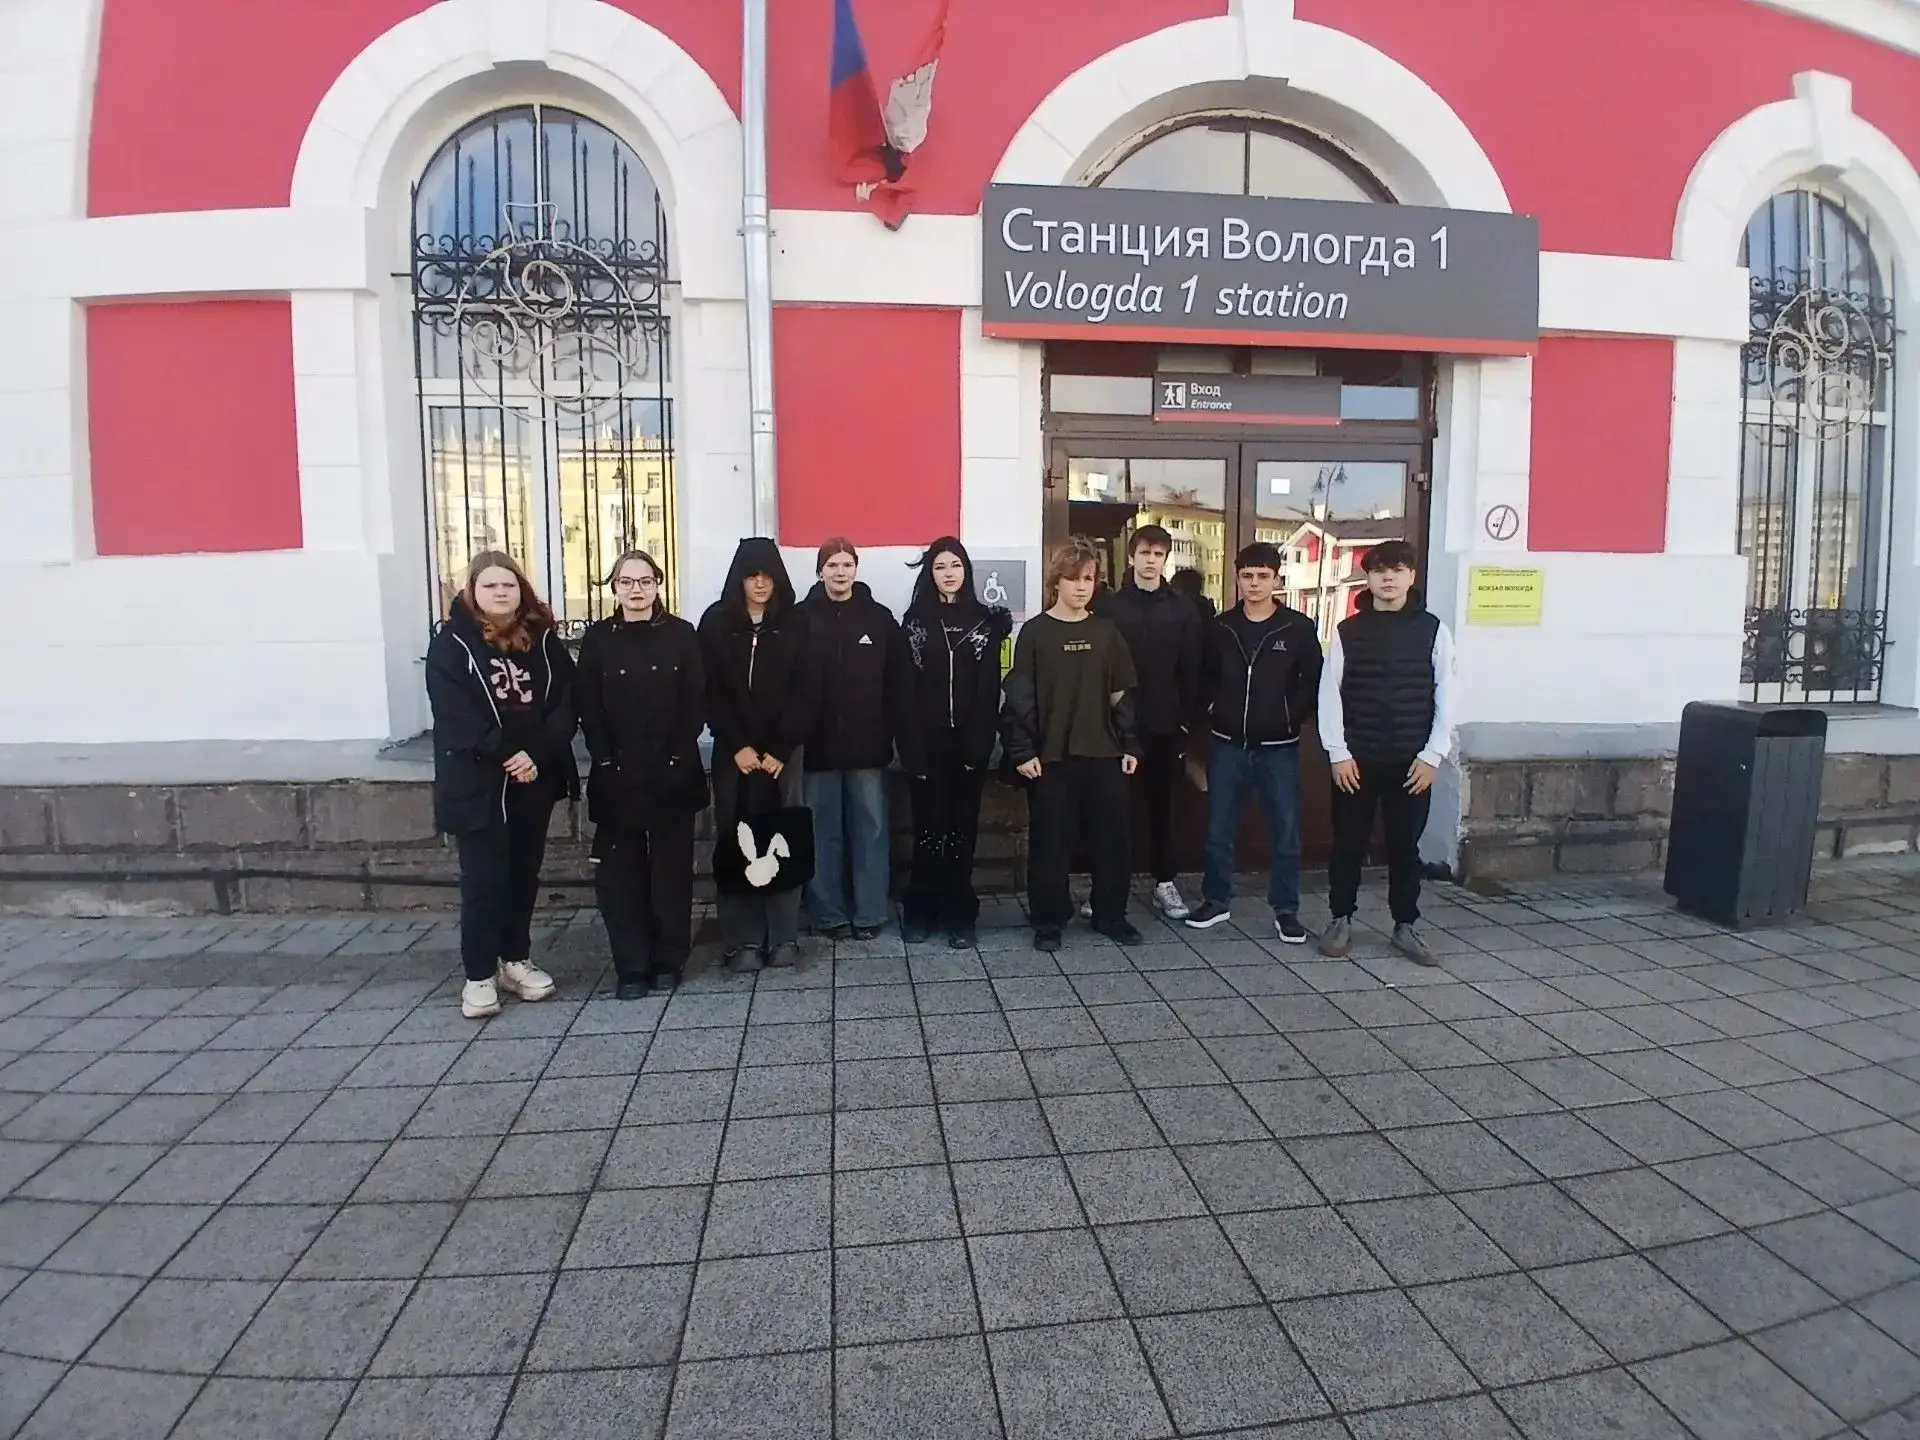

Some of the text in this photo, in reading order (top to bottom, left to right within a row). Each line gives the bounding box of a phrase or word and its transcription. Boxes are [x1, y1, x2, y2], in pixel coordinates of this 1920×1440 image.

[1002, 207, 1448, 277] Станция Вологда 1
[1005, 269, 1349, 323] Vologda 1 station
[1190, 382, 1222, 397] Вход
[1190, 399, 1233, 410] Entrance
